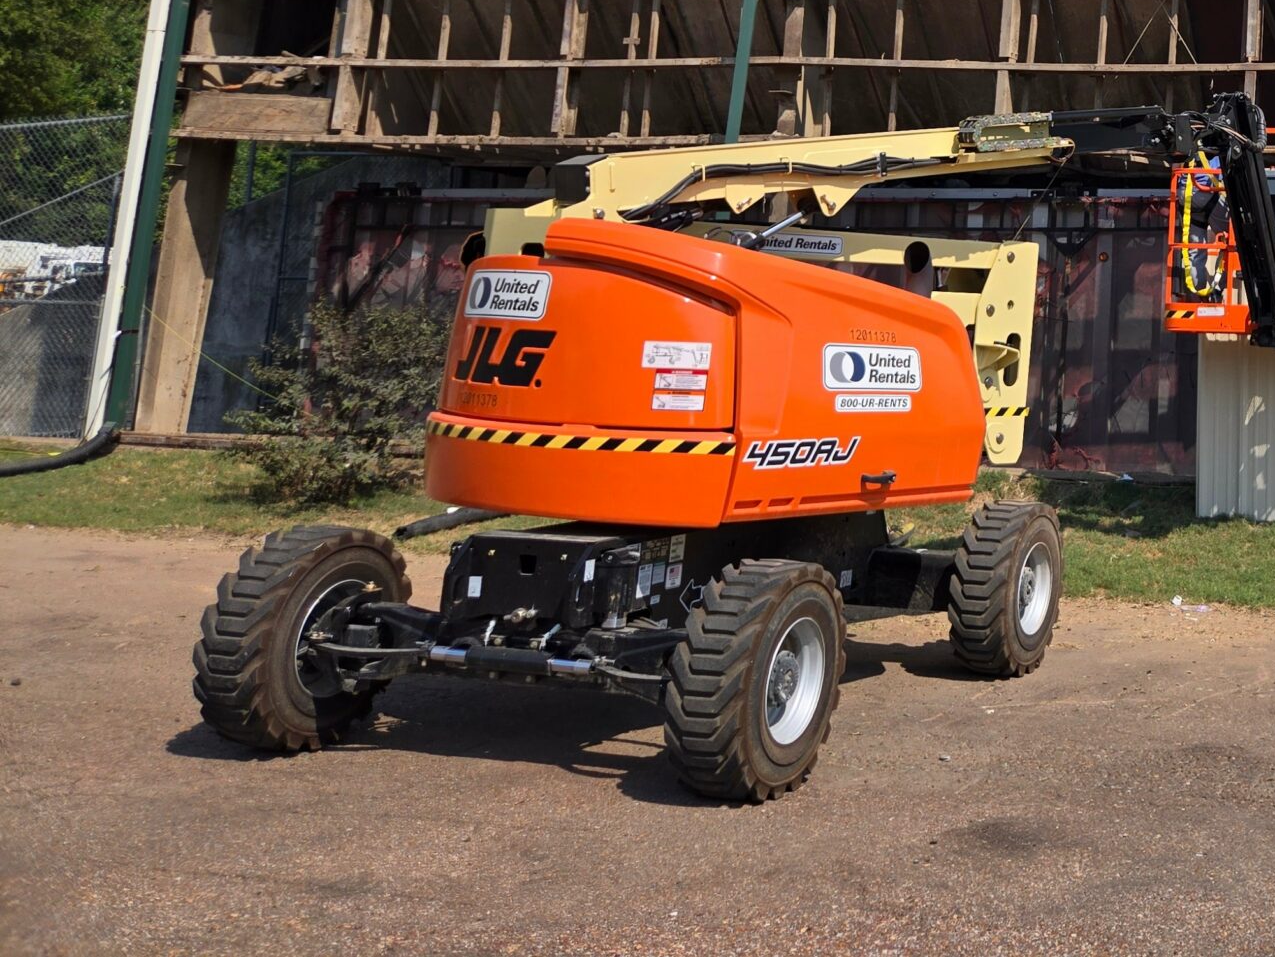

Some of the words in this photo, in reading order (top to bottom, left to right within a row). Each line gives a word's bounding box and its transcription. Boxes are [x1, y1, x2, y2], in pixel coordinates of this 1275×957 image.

[763, 236, 793, 248] nited
[795, 238, 838, 251] Rentals
[494, 277, 541, 295] United
[490, 295, 540, 312] Rentals
[849, 329, 897, 343] 12011378
[868, 352, 912, 369] United
[868, 369, 917, 384] Rentals
[840, 398, 909, 408] 800-UR-RENTS
[745, 437, 860, 468] 450AJ
